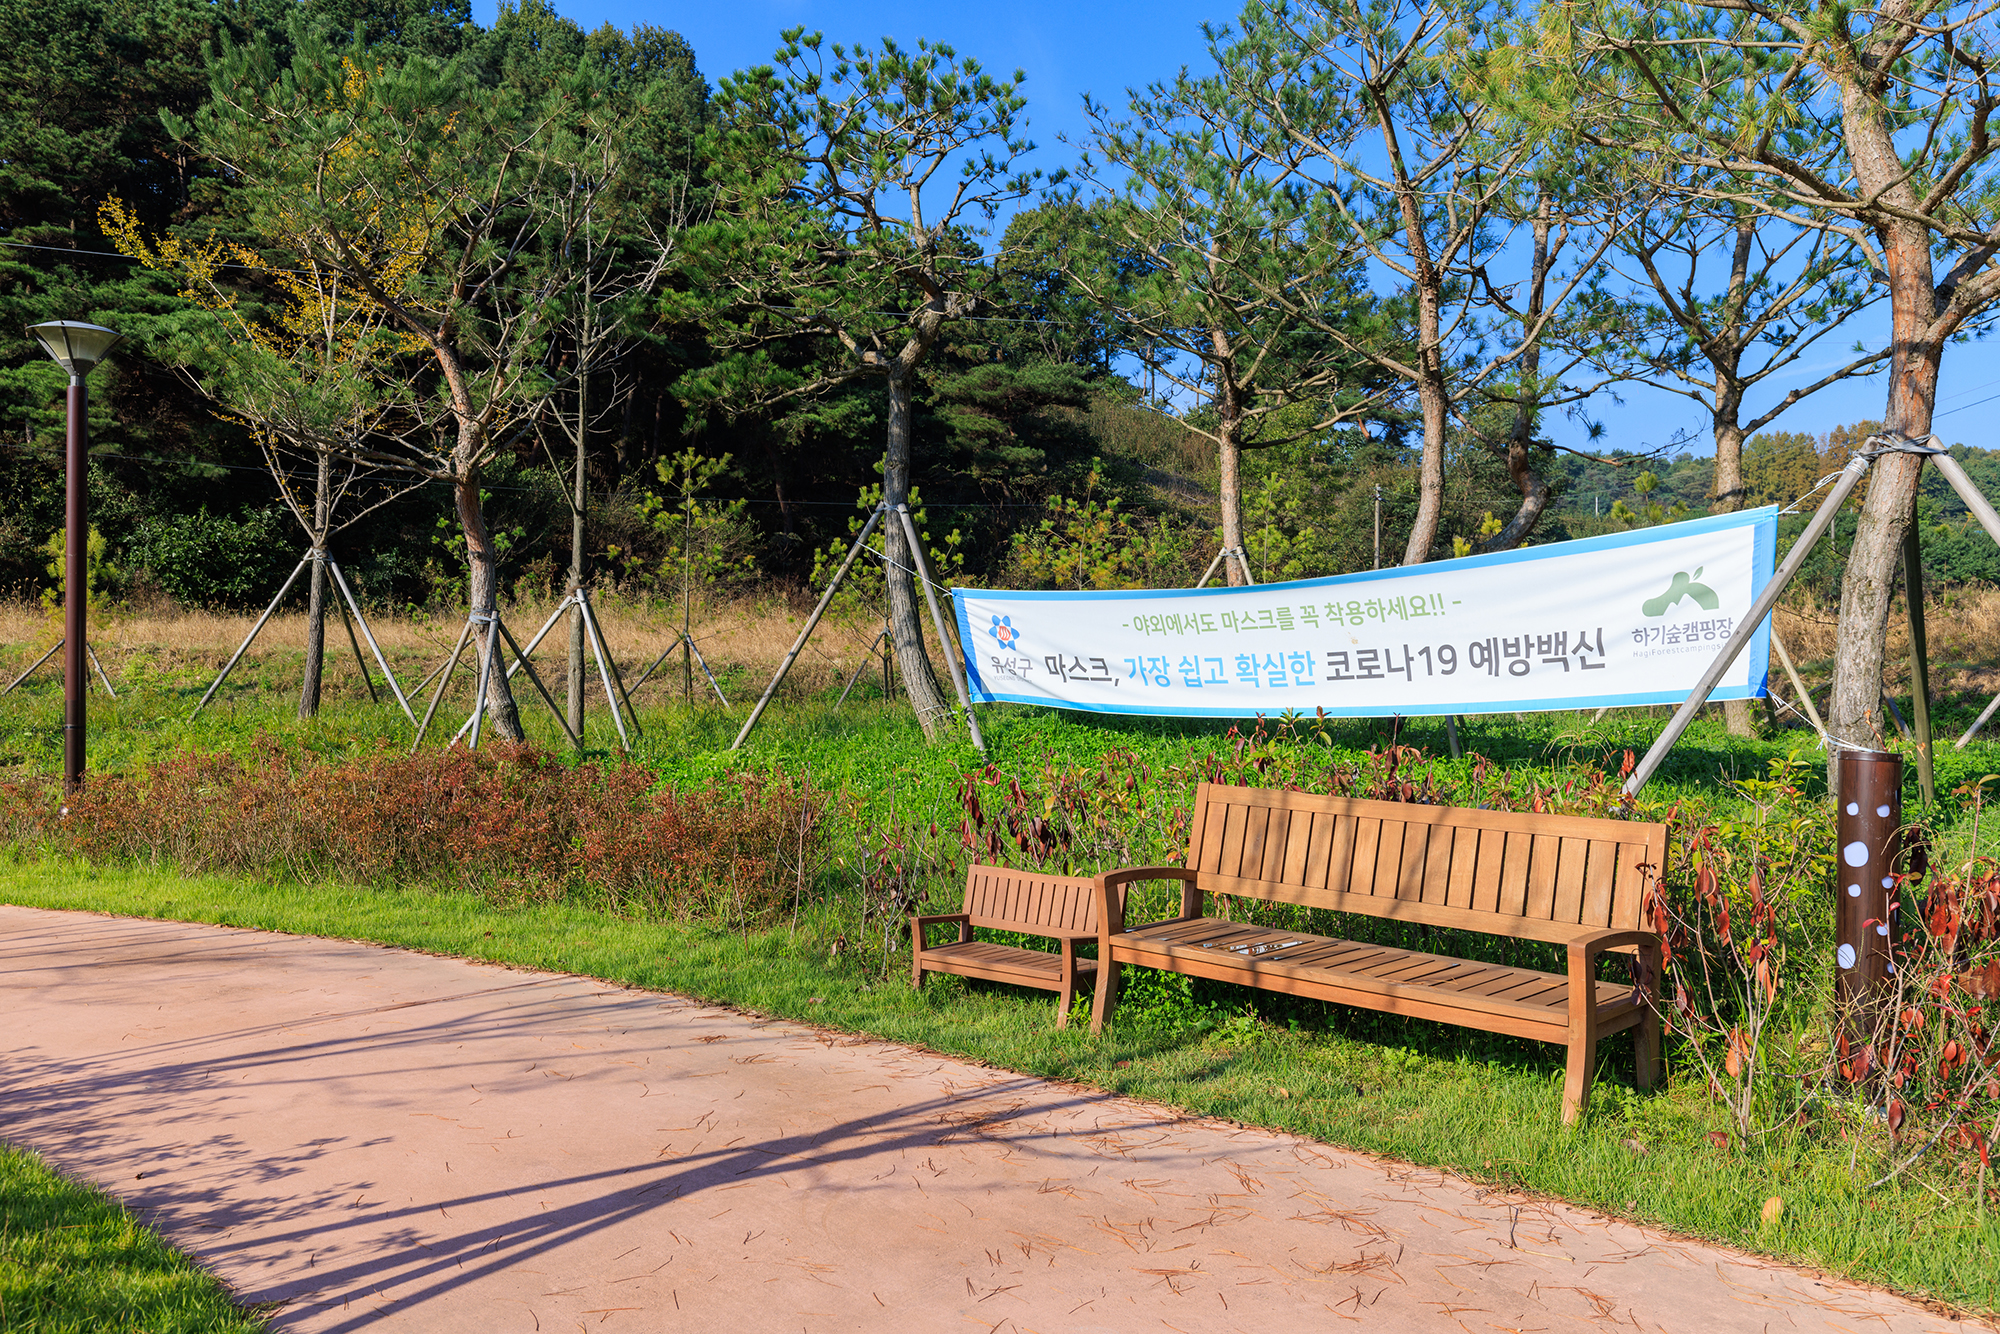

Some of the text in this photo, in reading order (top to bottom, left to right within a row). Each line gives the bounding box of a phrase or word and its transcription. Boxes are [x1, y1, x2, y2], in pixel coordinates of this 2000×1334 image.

[1132, 612, 1218, 636] 야외에서도
[1220, 606, 1295, 633] 마스크를
[1299, 604, 1320, 629] 꼭
[1323, 593, 1446, 627] 착용하세요!!
[1631, 617, 1733, 647] 하기숲캠핑장
[991, 656, 1034, 678] 유성구
[1044, 627, 1606, 689] 마스크, 가장 쉽고 확실한 코로나19 예방백신
